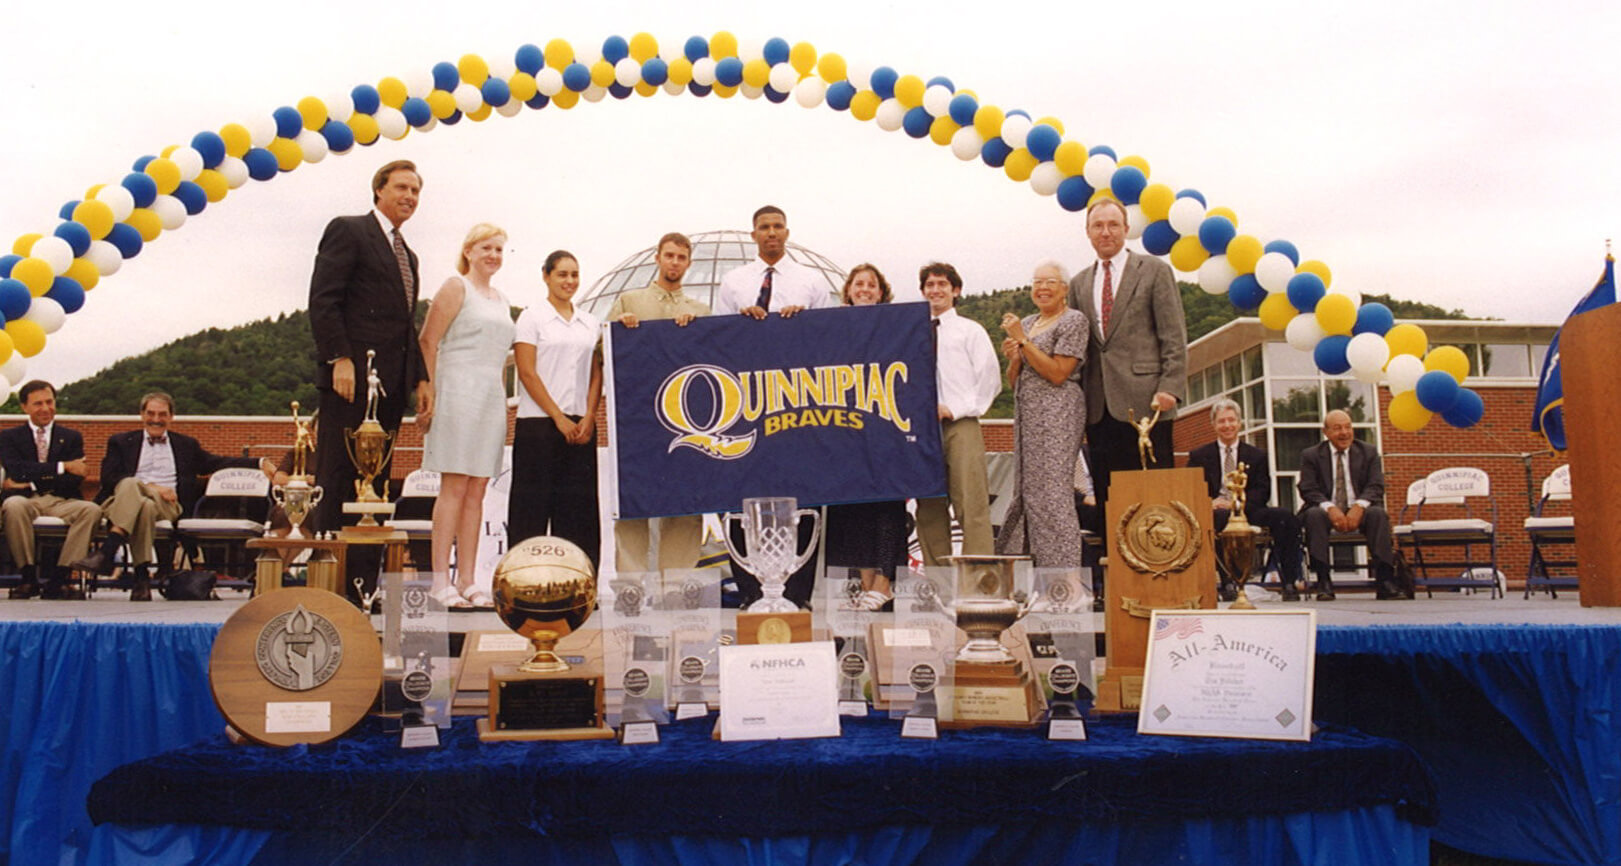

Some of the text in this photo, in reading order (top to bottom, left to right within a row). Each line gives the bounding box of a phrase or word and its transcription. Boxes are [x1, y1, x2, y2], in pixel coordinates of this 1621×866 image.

[655, 361, 911, 459] QUINNIPIAC
[764, 409, 865, 436] BRAVES
[905, 435, 917, 443] TM
[220, 481, 257, 491] COLLEGE
[1437, 481, 1475, 491] COLLEGE
[1168, 633, 1289, 672] All-America
[762, 657, 806, 669] NFHCA
